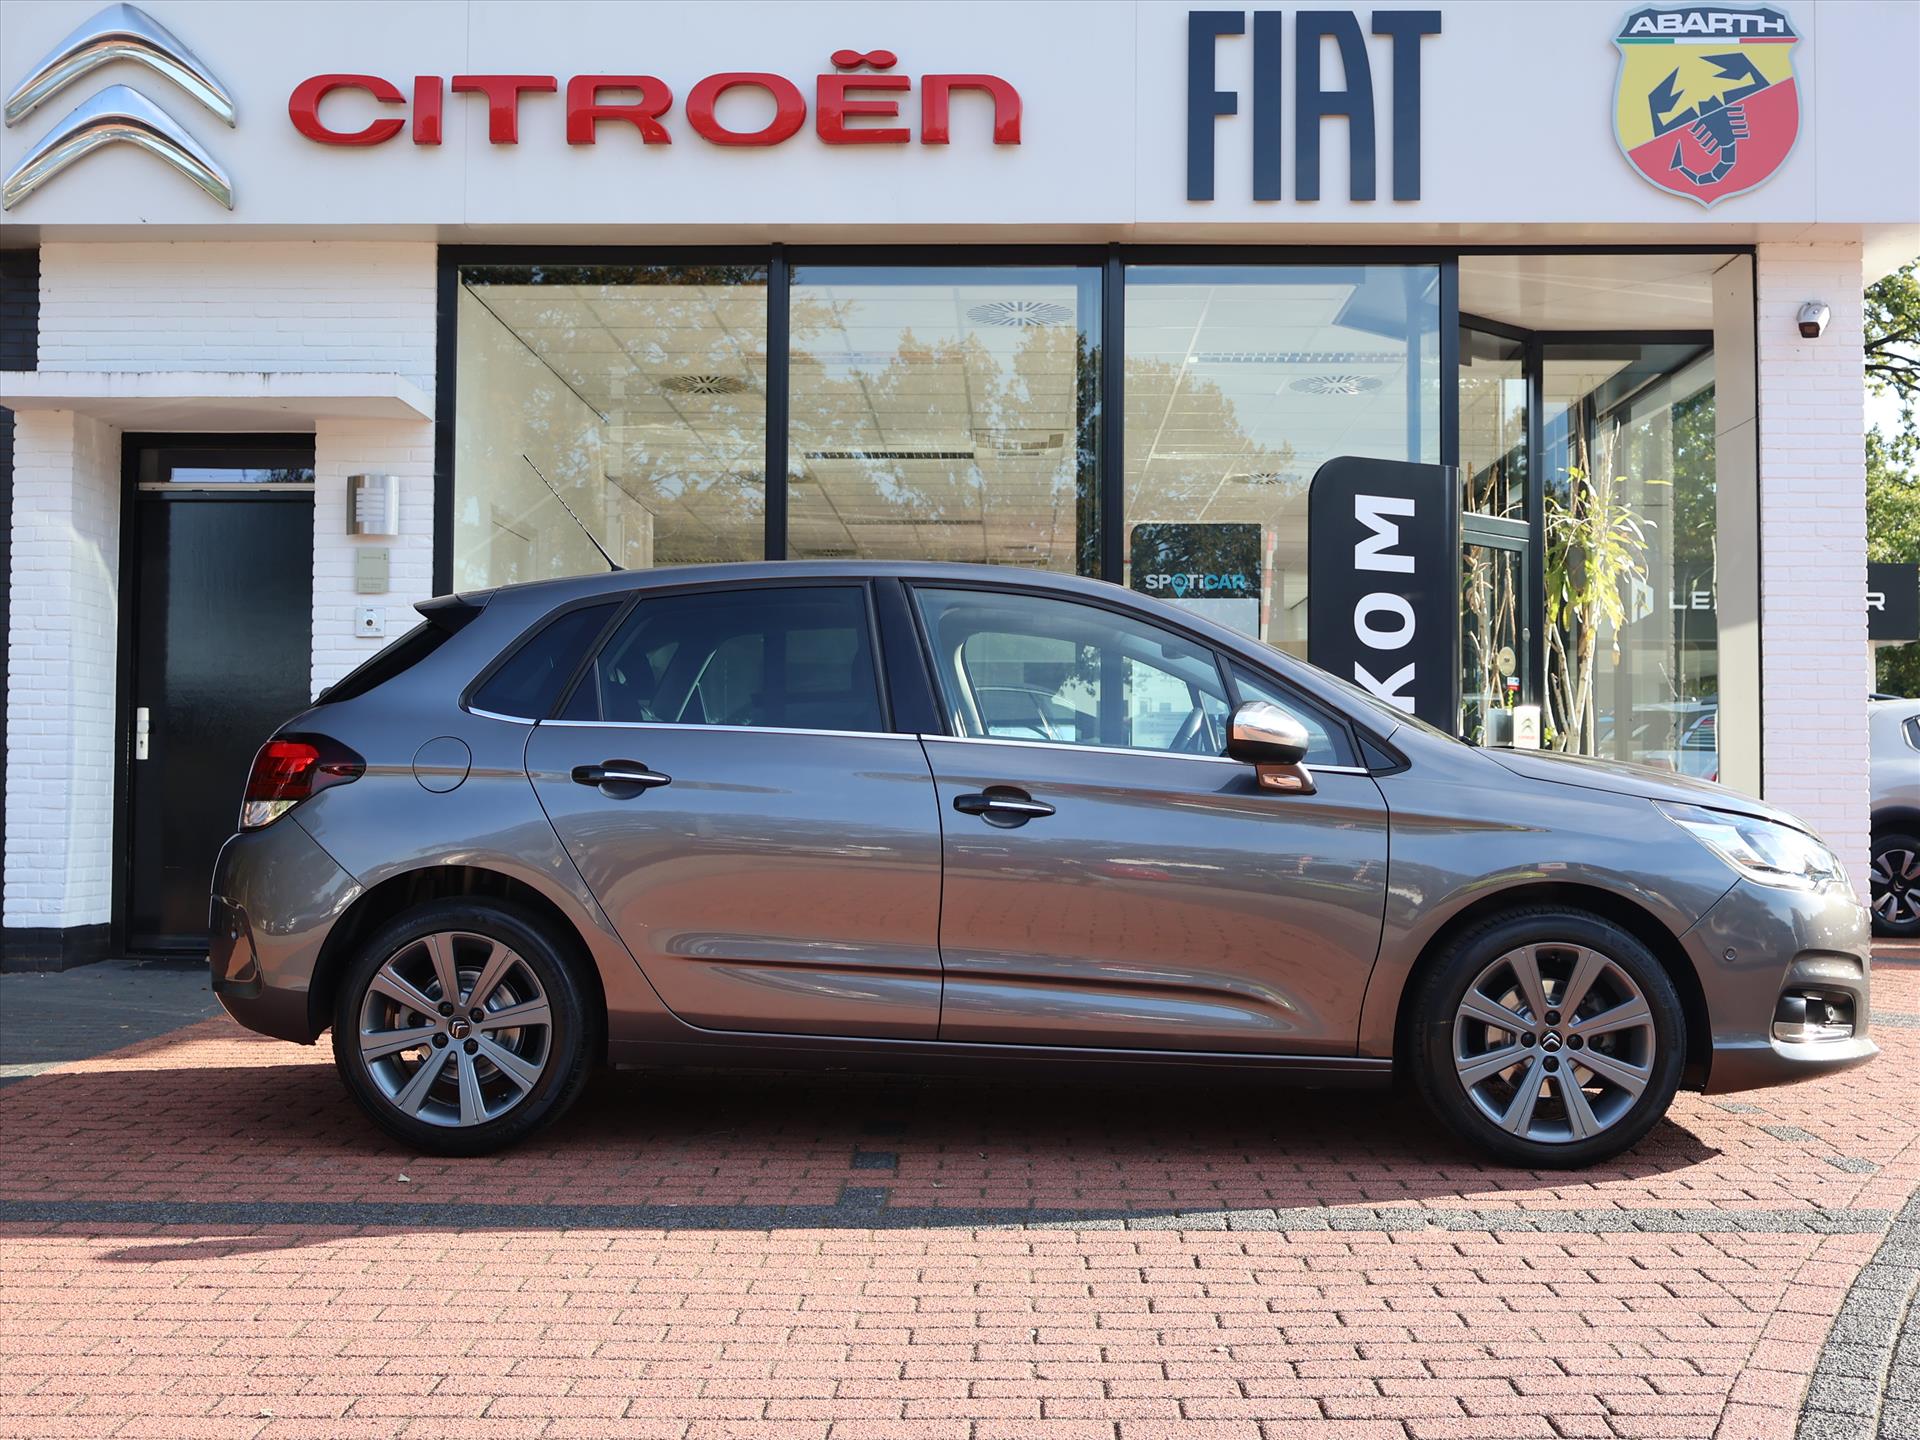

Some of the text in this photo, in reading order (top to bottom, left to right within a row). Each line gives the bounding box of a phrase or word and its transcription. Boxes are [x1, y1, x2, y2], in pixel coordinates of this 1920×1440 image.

[1629, 12, 1785, 34] ABARTH
[288, 49, 1023, 146] CITROËN
[1187, 10, 1441, 201] FIAT
[1145, 573, 1245, 597] SPOTiCAR
[1353, 494, 1417, 715] KOM
[1669, 591, 1718, 610] LE
